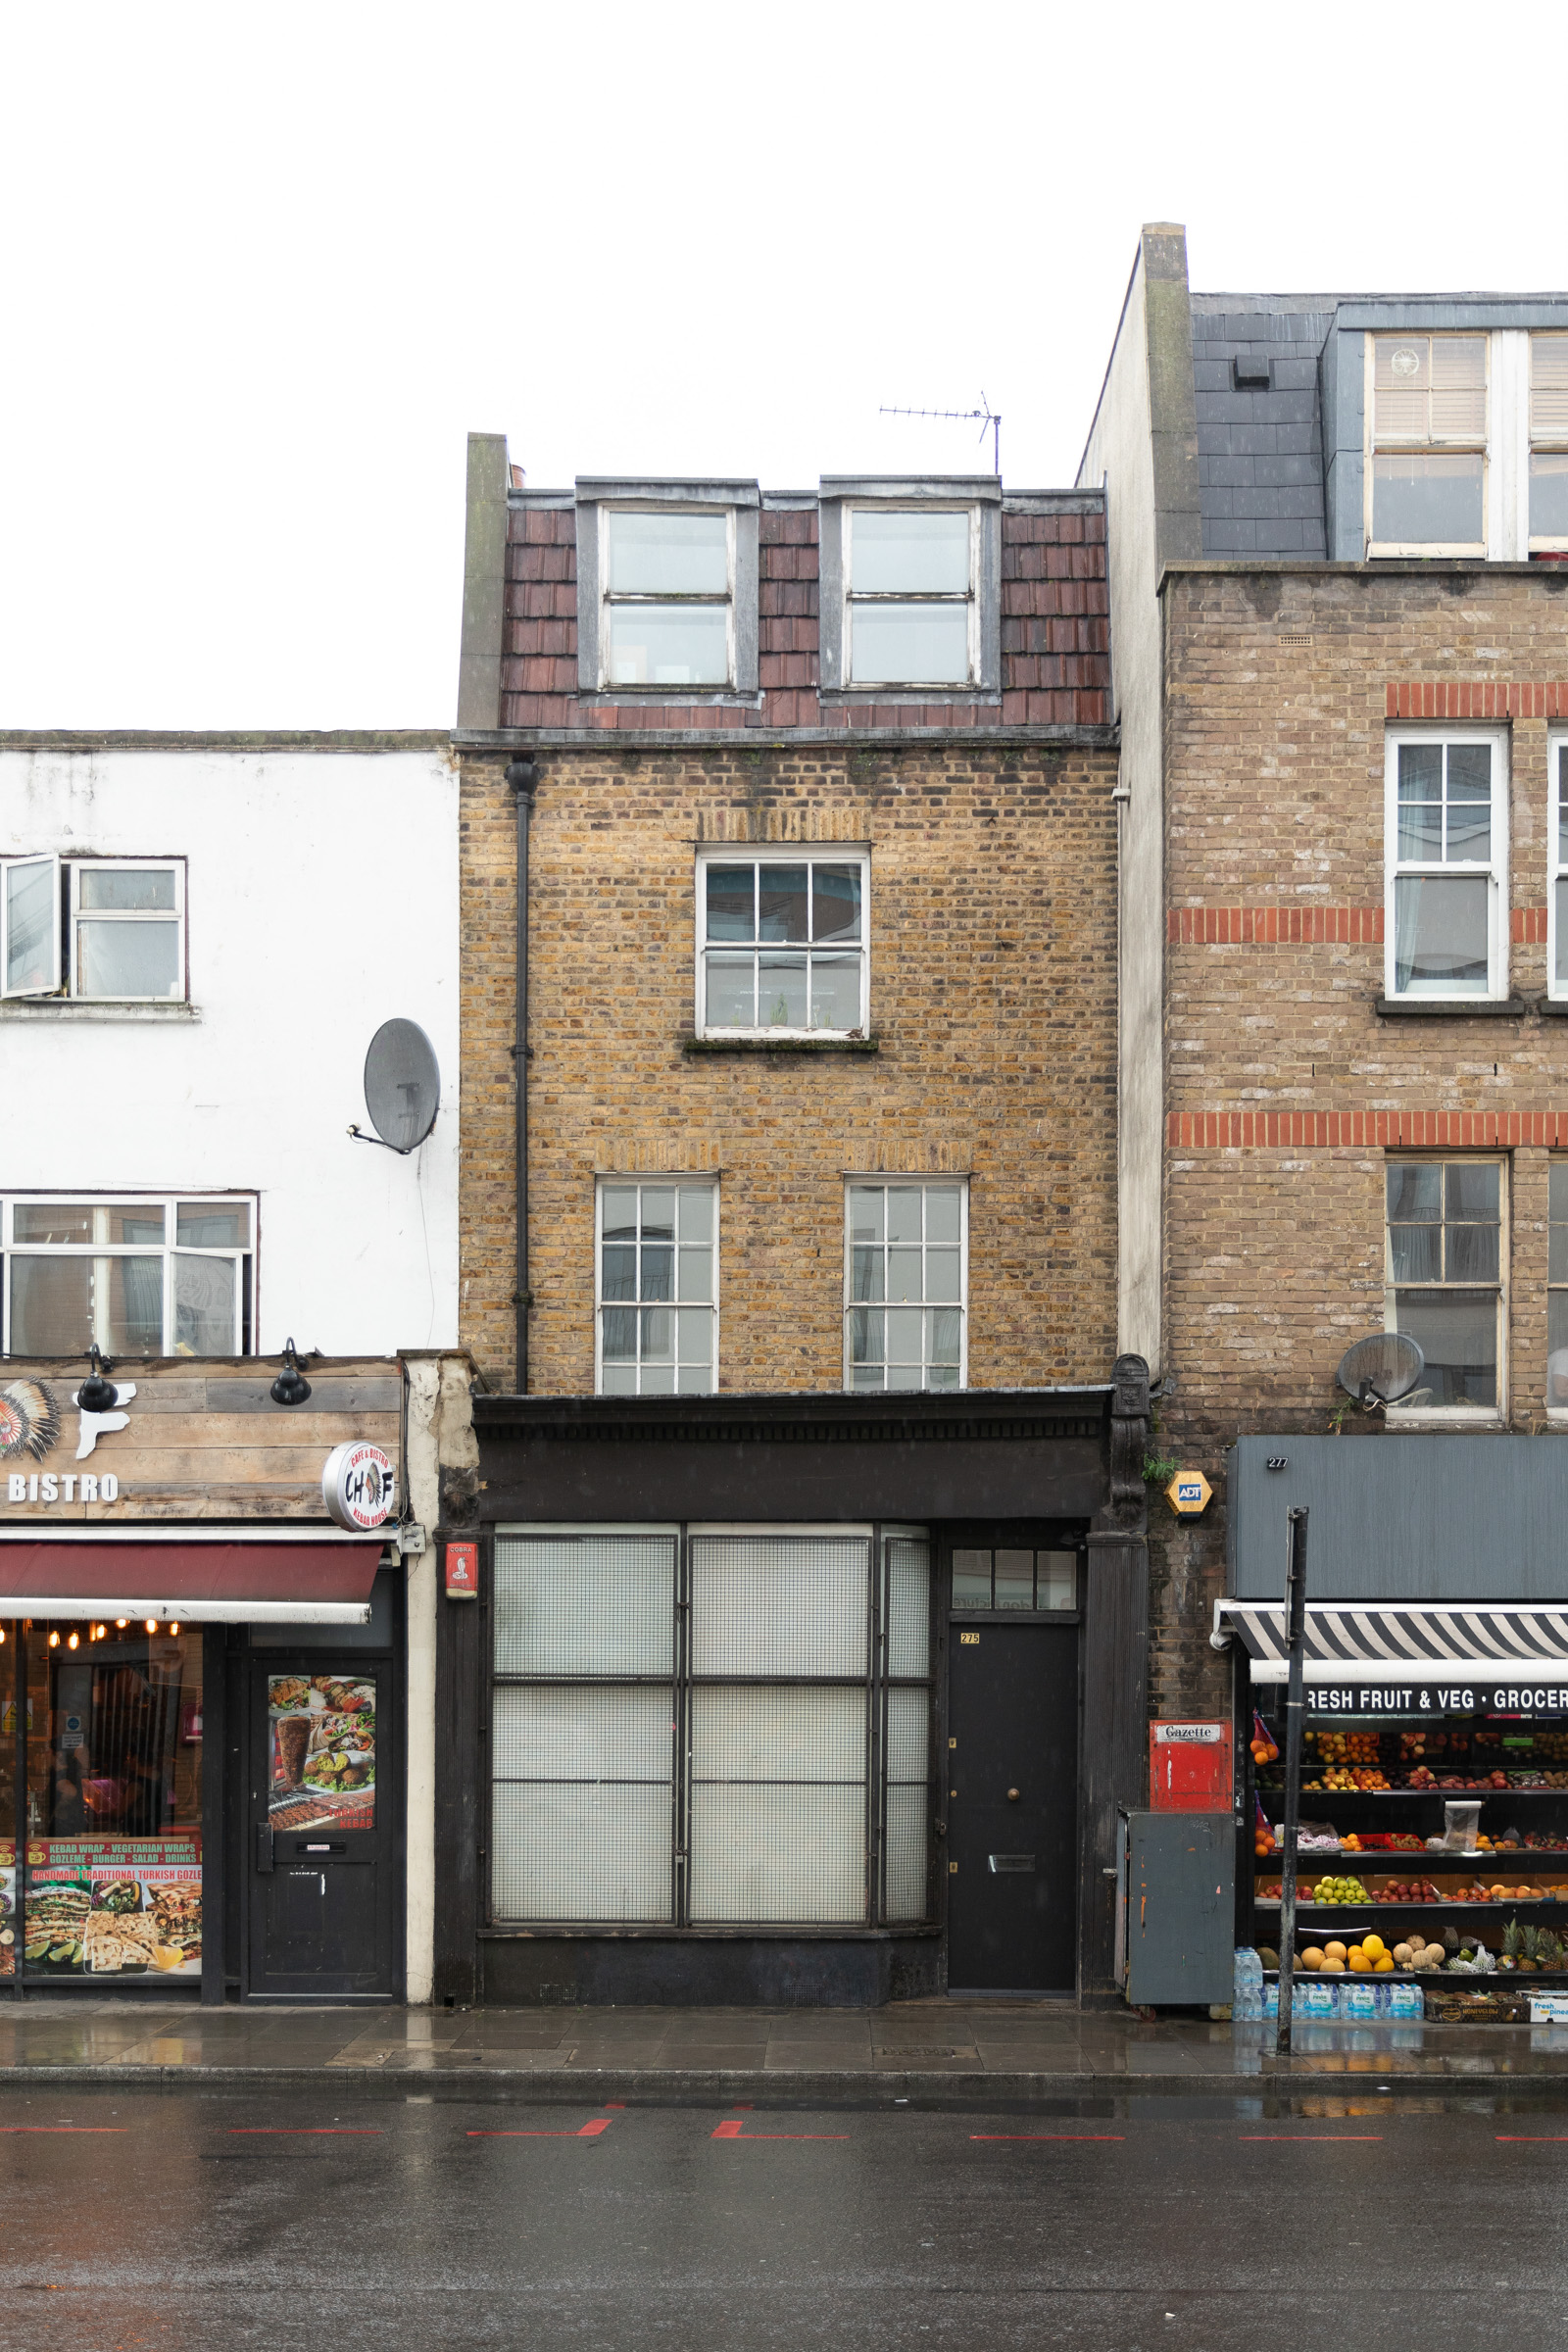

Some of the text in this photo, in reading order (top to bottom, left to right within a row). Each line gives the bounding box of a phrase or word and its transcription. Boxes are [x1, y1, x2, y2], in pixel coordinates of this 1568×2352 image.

[351, 1449, 365, 1468] CAFE
[369, 1447, 389, 1469] BISTRO
[1267, 1456, 1289, 1468] 277
[8, 1473, 119, 1502] BISTRO
[1179, 1487, 1201, 1498] ADT
[353, 1506, 388, 1526] KEBAB HOUSE
[961, 1634, 979, 1642] 275
[1307, 1690, 1353, 1709] RESH
[1359, 1690, 1412, 1709] FRUIT
[1419, 1690, 1431, 1709] &
[1438, 1690, 1474, 1709] VEG
[1494, 1689, 1568, 1708] GROCER
[1165, 1726, 1211, 1738] Gazette
[328, 1807, 373, 1818] TURKISH
[339, 1818, 373, 1829] KEBAB
[49, 1843, 77, 1854] KEBAB
[78, 1843, 105, 1854] WRAP
[111, 1843, 163, 1853] VEGETARIAN
[164, 1843, 196, 1853] WRAPS
[49, 1854, 86, 1864] GOZLEME
[92, 1854, 126, 1864] BURGER
[132, 1853, 159, 1864] SALAD
[165, 1853, 197, 1863] DRINKS
[31, 1869, 80, 1881] HANDMADE
[81, 1870, 136, 1881] TRADITIONAL
[138, 1869, 175, 1881] TURKISH
